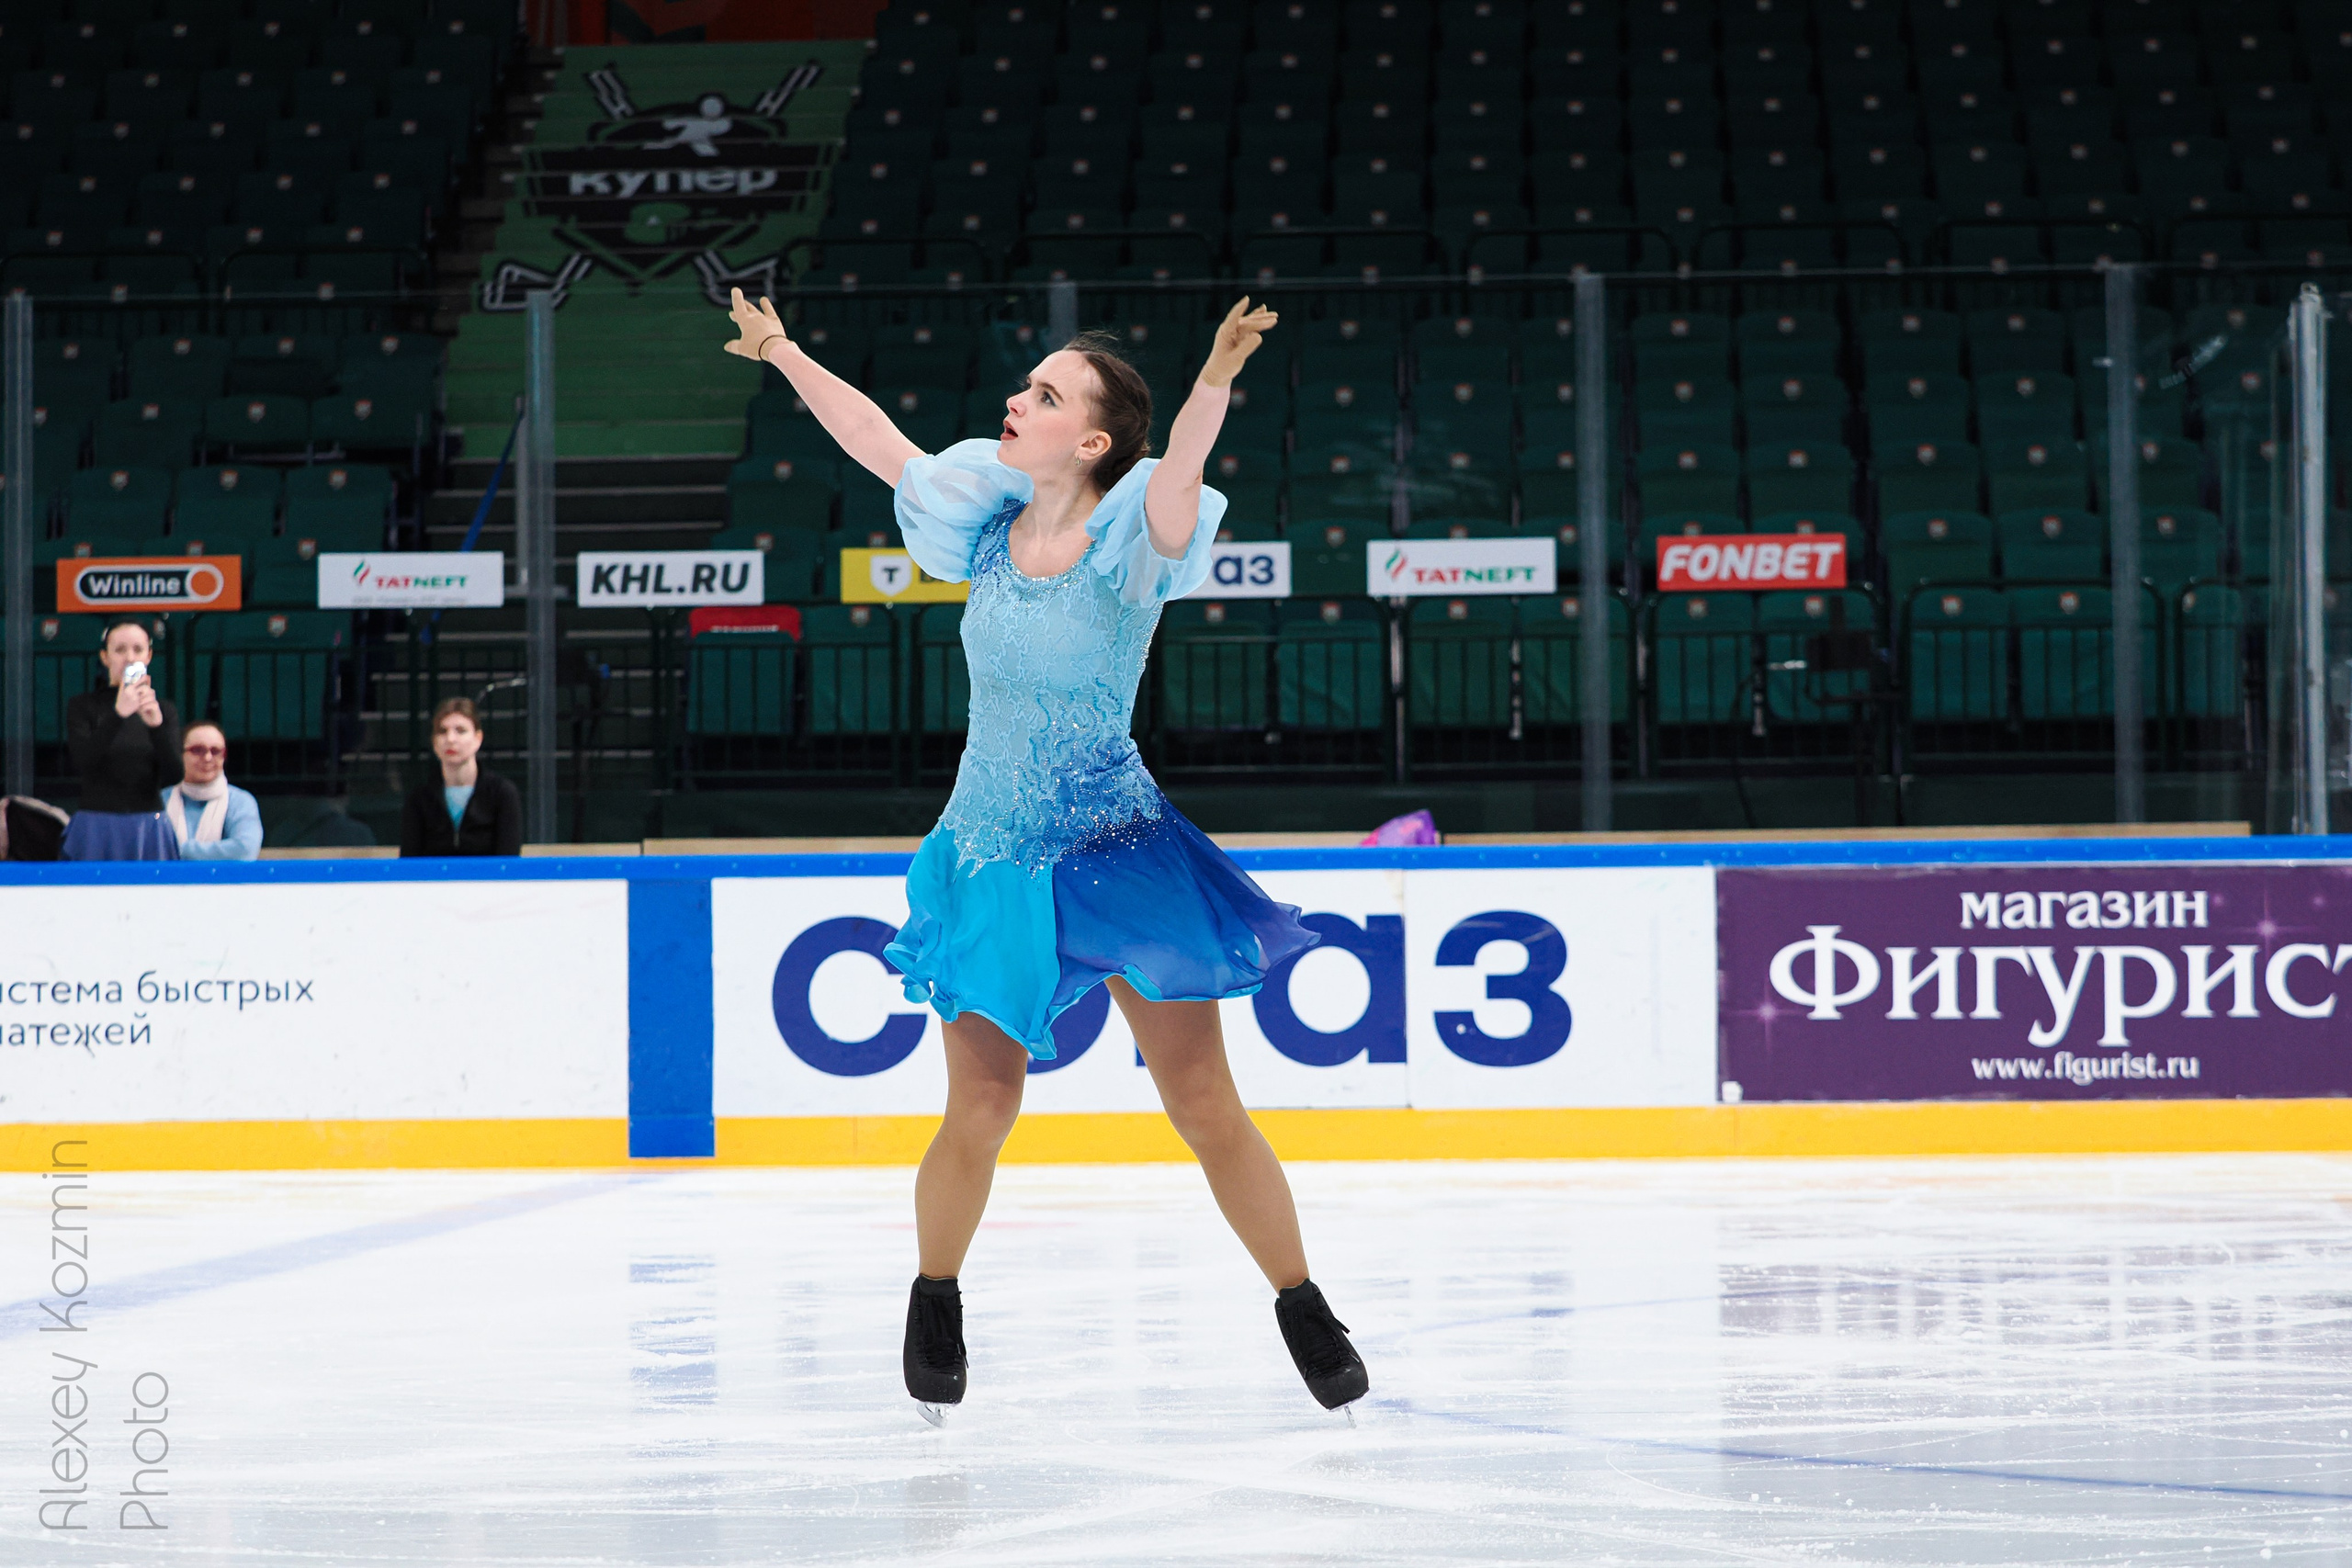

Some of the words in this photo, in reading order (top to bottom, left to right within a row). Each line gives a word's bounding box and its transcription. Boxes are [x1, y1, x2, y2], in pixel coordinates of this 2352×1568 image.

[591, 561, 750, 594] KHL.RU
[1412, 565, 1536, 585] TATNEFT
[1659, 542, 1842, 582] FONBET
[86, 573, 181, 596] Winline
[375, 575, 468, 589] TATNEFT
[1960, 890, 2209, 930] магазин
[137, 970, 314, 1011] быстрых
[1972, 1051, 2200, 1086] www.figurist.ru
